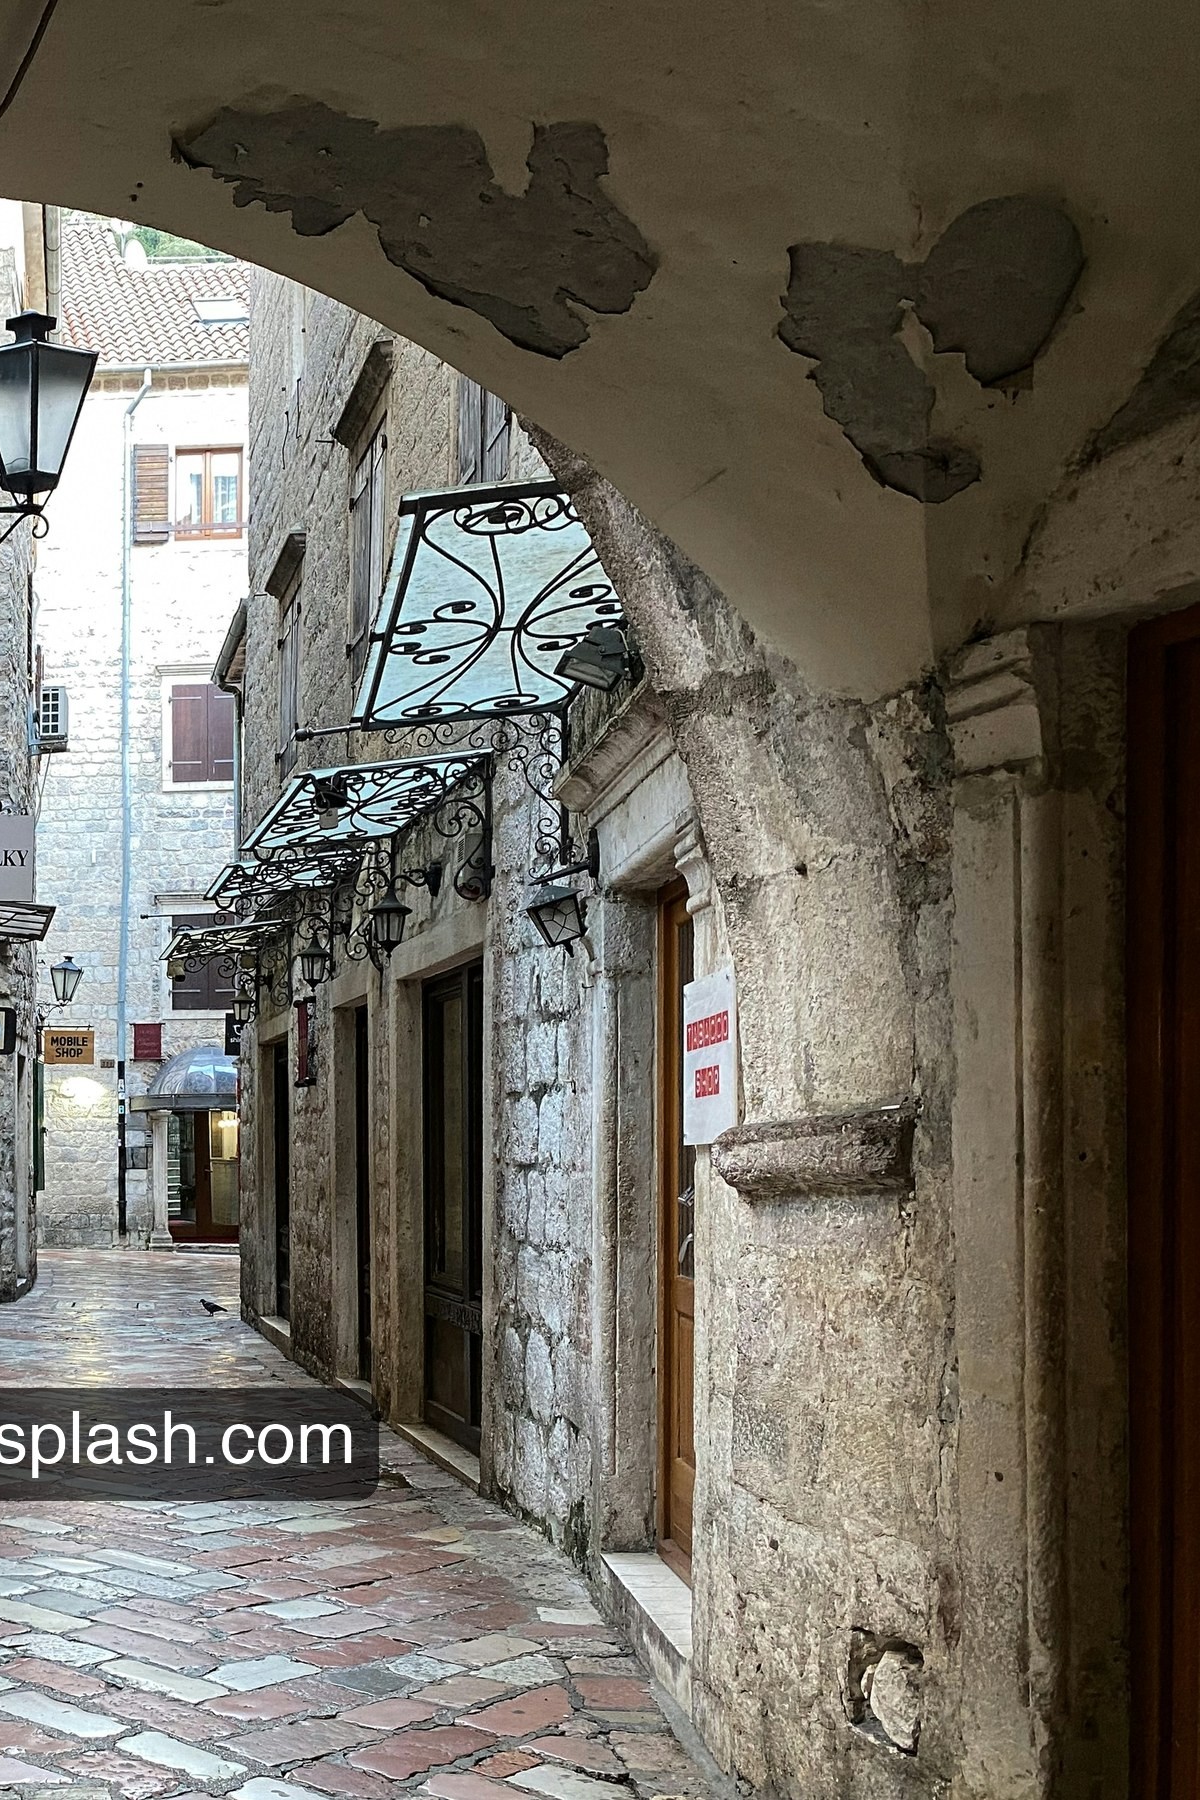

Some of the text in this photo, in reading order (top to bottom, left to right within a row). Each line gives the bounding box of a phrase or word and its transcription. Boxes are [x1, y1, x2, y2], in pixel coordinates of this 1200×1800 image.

[50, 1036, 89, 1047] MOBILE
[55, 1047, 83, 1058] SHOP
[695, 1066, 719, 1098] SHOP
